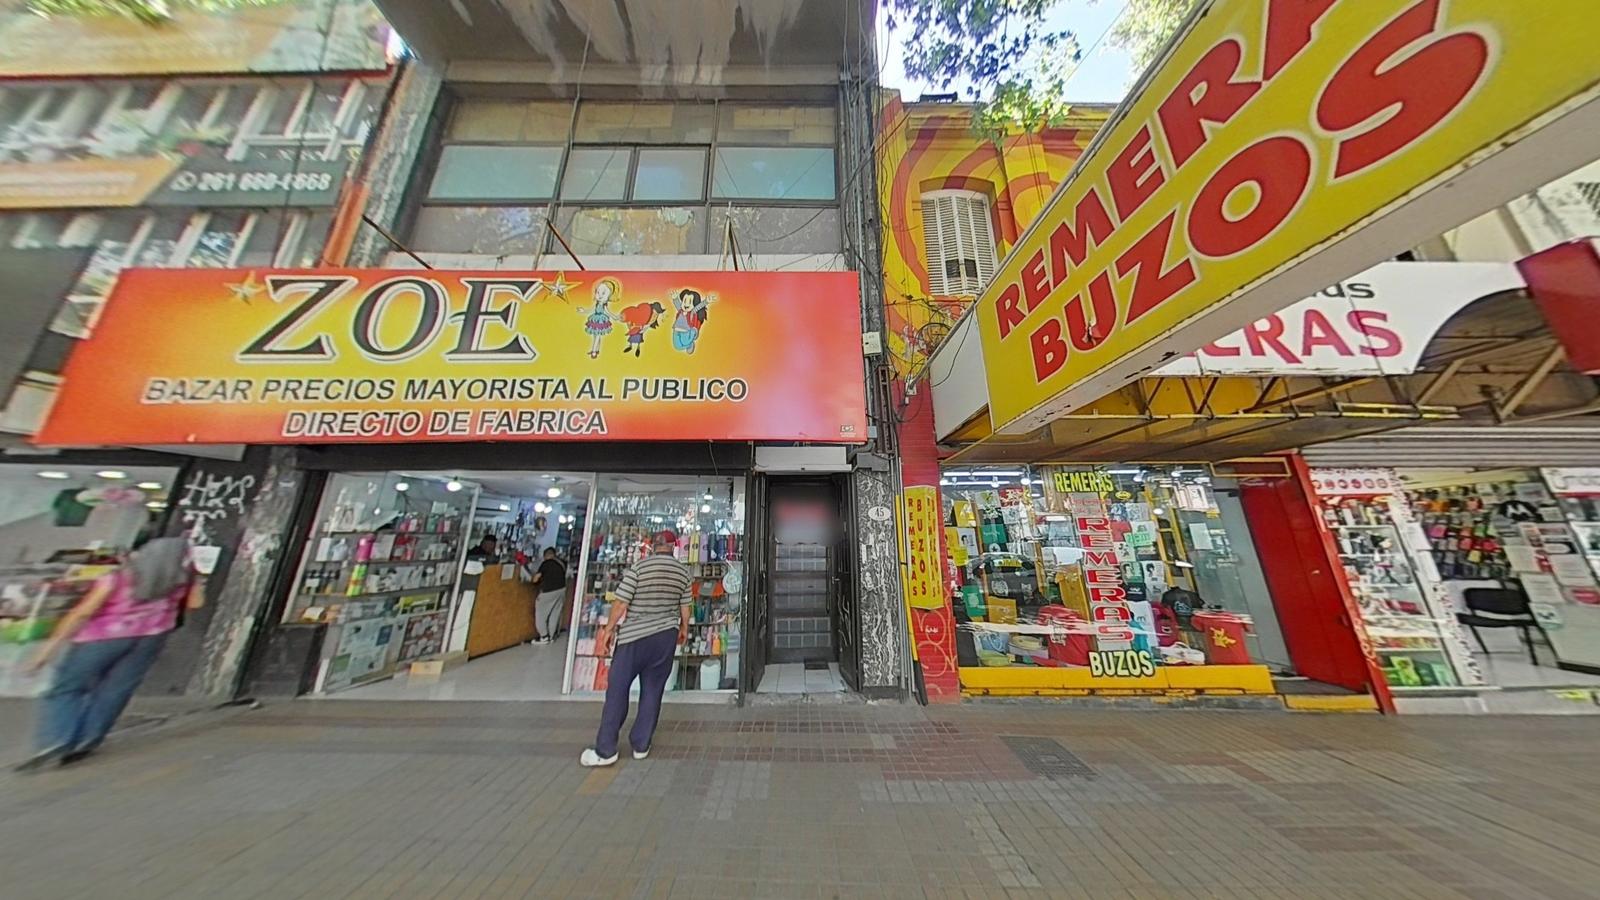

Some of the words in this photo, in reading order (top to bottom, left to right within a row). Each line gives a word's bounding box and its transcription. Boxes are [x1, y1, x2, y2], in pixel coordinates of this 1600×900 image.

[1030, 0, 1488, 384] BUZOS
[238, 277, 542, 362] ZOE
[145, 378, 252, 401] BAZAR
[260, 378, 395, 401] PRECIOS
[403, 378, 570, 401] MAYORISTA
[576, 378, 613, 400] AL
[622, 378, 748, 400] PUBLICO
[286, 410, 422, 434] DIRECTO
[429, 410, 469, 433] DE
[478, 409, 607, 433] FABRICA
[1053, 471, 1115, 493] REMERAS
[907, 498, 918, 597] REMERAS
[916, 499, 927, 596] BUZOS
[1077, 517, 1135, 642] REMERAS
[1088, 651, 1154, 678] BUZOS
